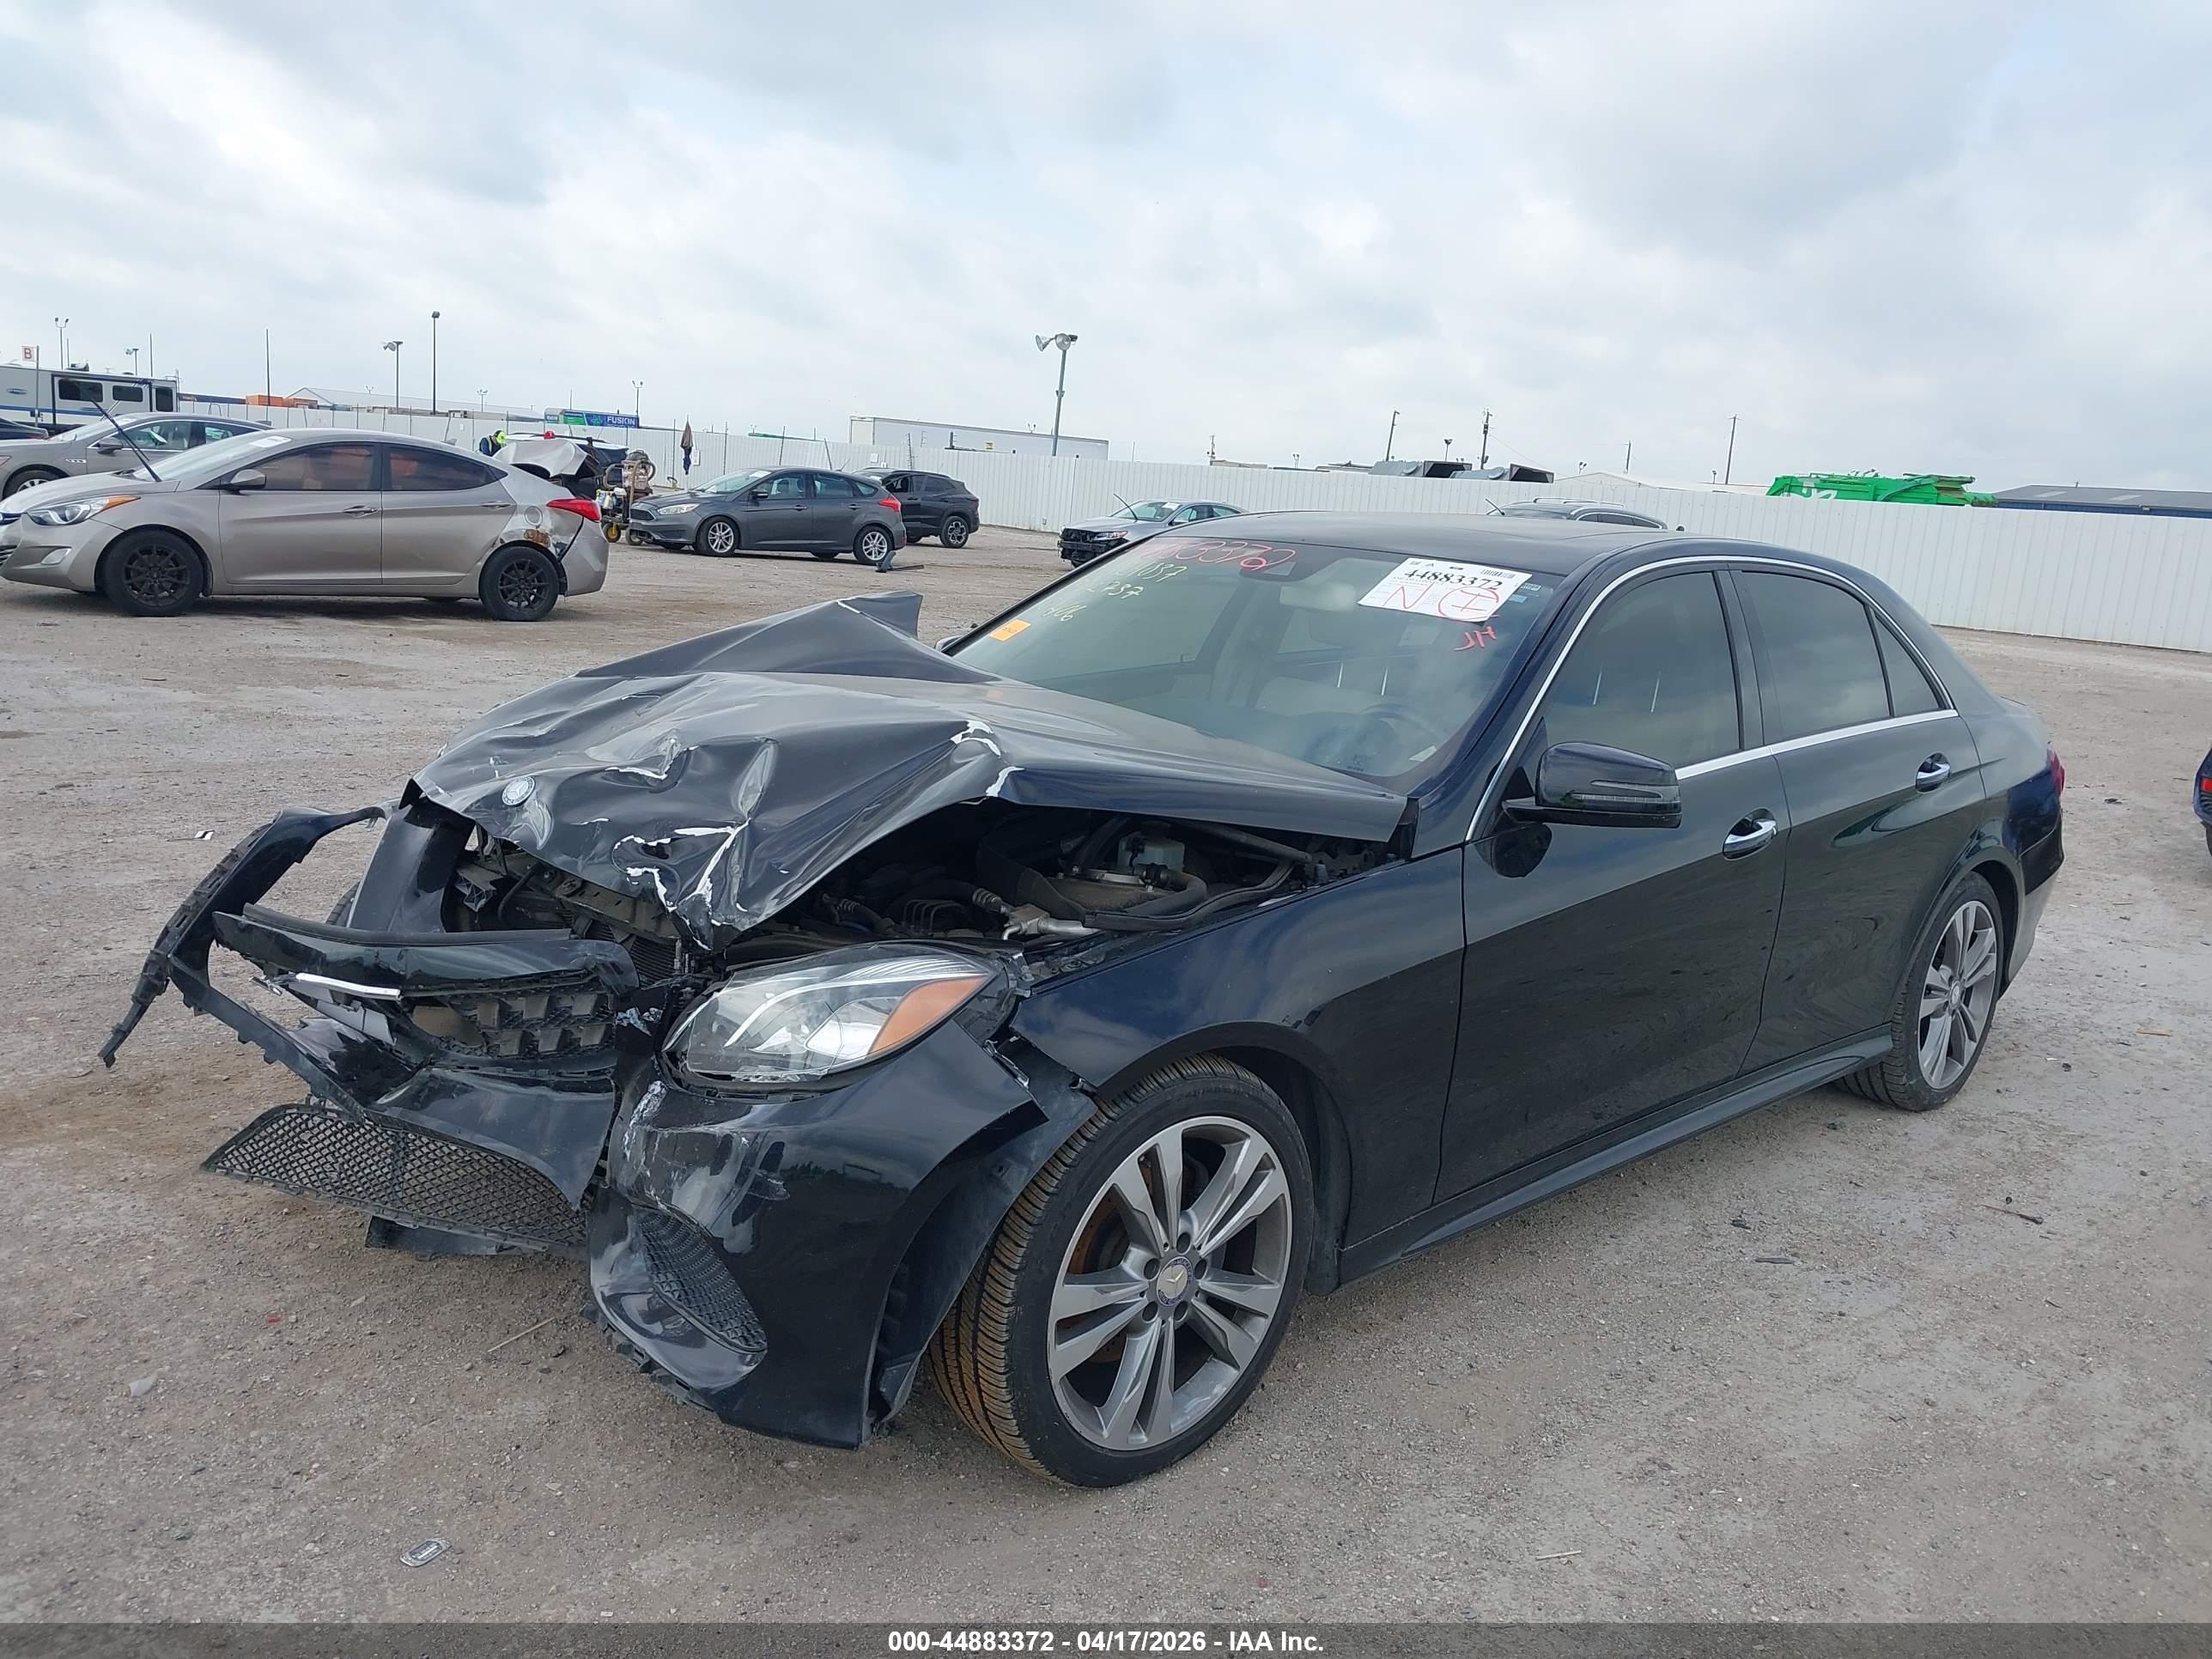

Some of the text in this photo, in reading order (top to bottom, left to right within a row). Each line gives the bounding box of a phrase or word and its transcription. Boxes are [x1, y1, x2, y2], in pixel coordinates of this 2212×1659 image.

[24, 348, 32, 359] B
[607, 416, 635, 425] FUSION
[1403, 569, 1504, 591] 44883372
